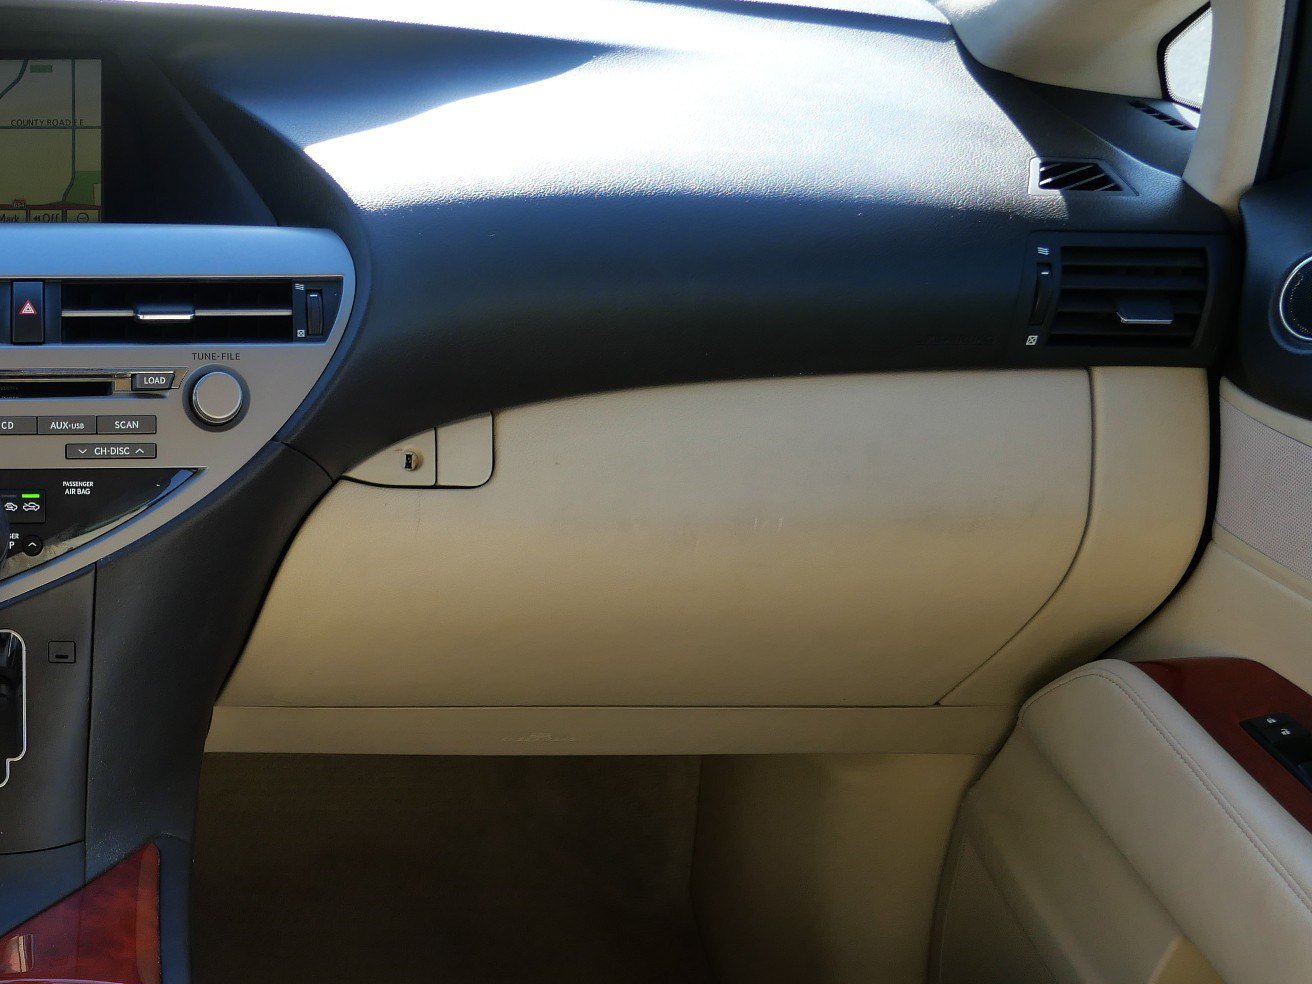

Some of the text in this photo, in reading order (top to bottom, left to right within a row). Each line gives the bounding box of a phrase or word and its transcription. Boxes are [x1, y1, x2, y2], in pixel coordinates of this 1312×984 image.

[10, 119, 45, 127] COUNTY
[42, 213, 60, 223] Off
[143, 376, 166, 385] LOAD
[0, 421, 14, 430] CD
[114, 420, 139, 429] SCAN
